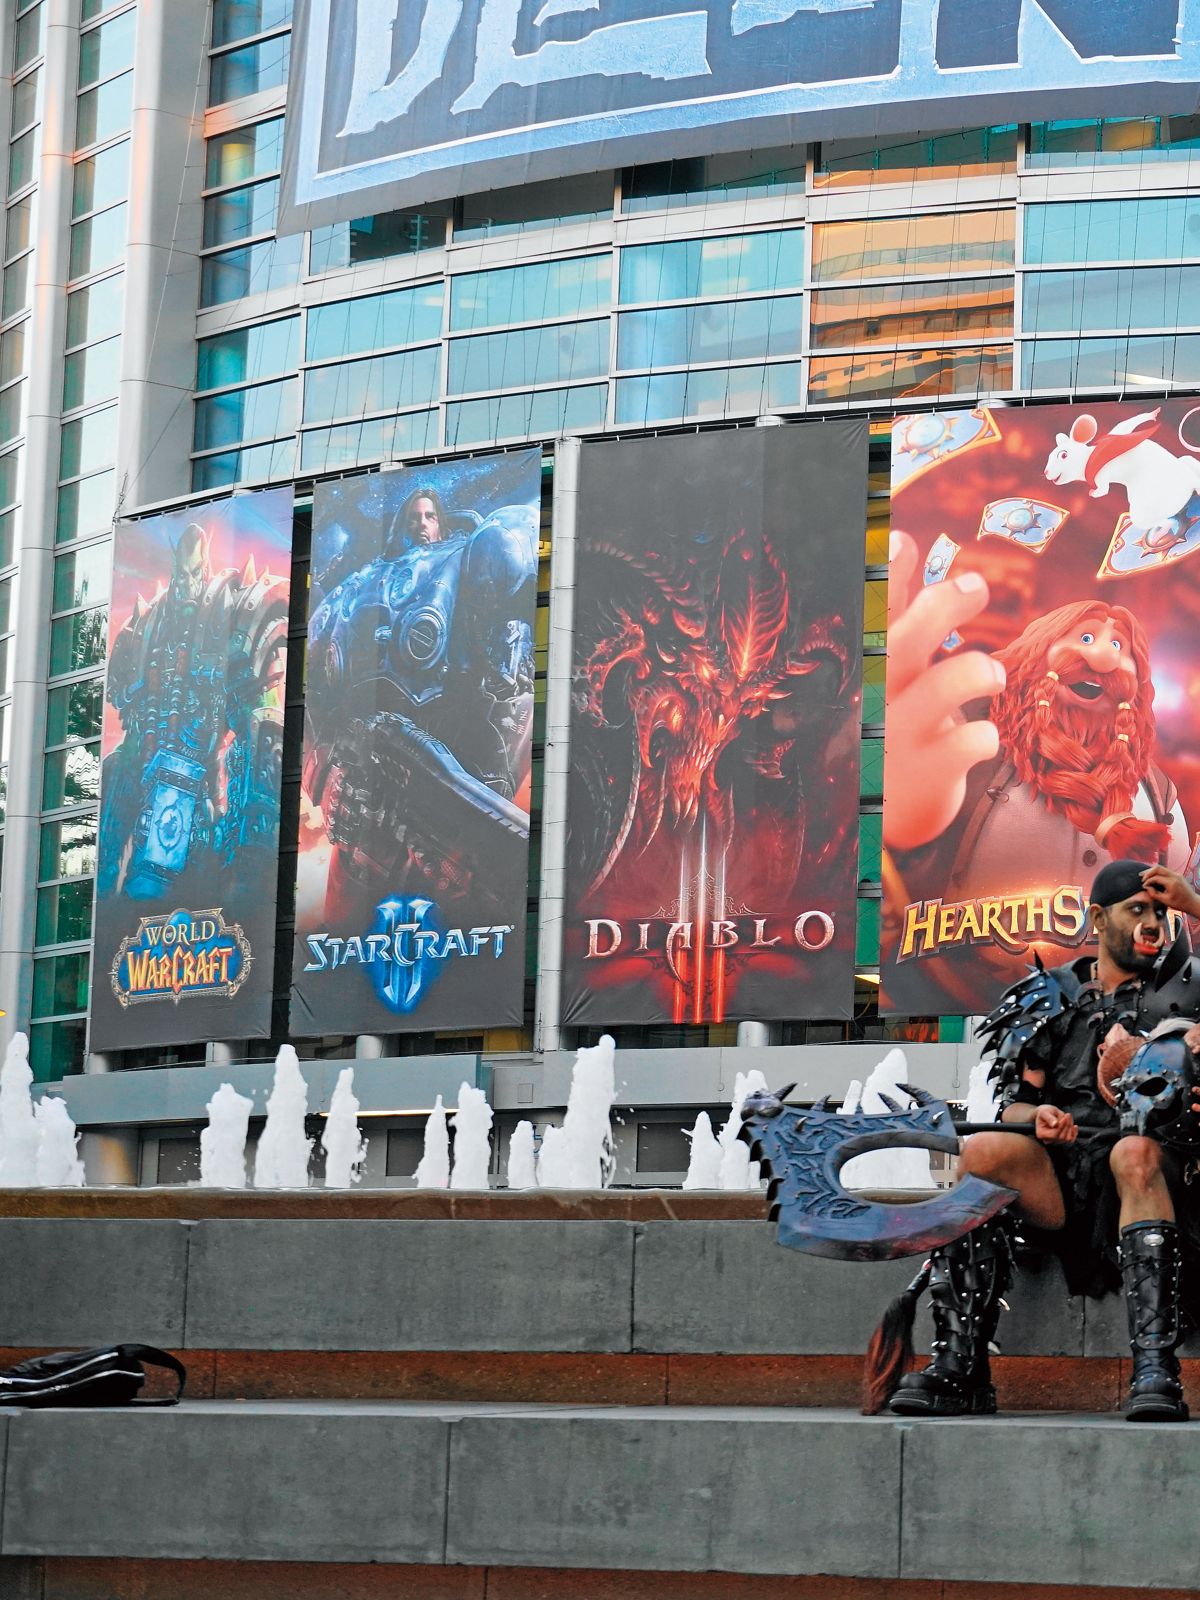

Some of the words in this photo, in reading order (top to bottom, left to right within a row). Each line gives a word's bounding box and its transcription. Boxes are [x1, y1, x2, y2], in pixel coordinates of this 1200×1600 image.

[145, 920, 216, 946] WORLD
[583, 910, 835, 986] DIABLO
[127, 945, 233, 994] WARCRAFT
